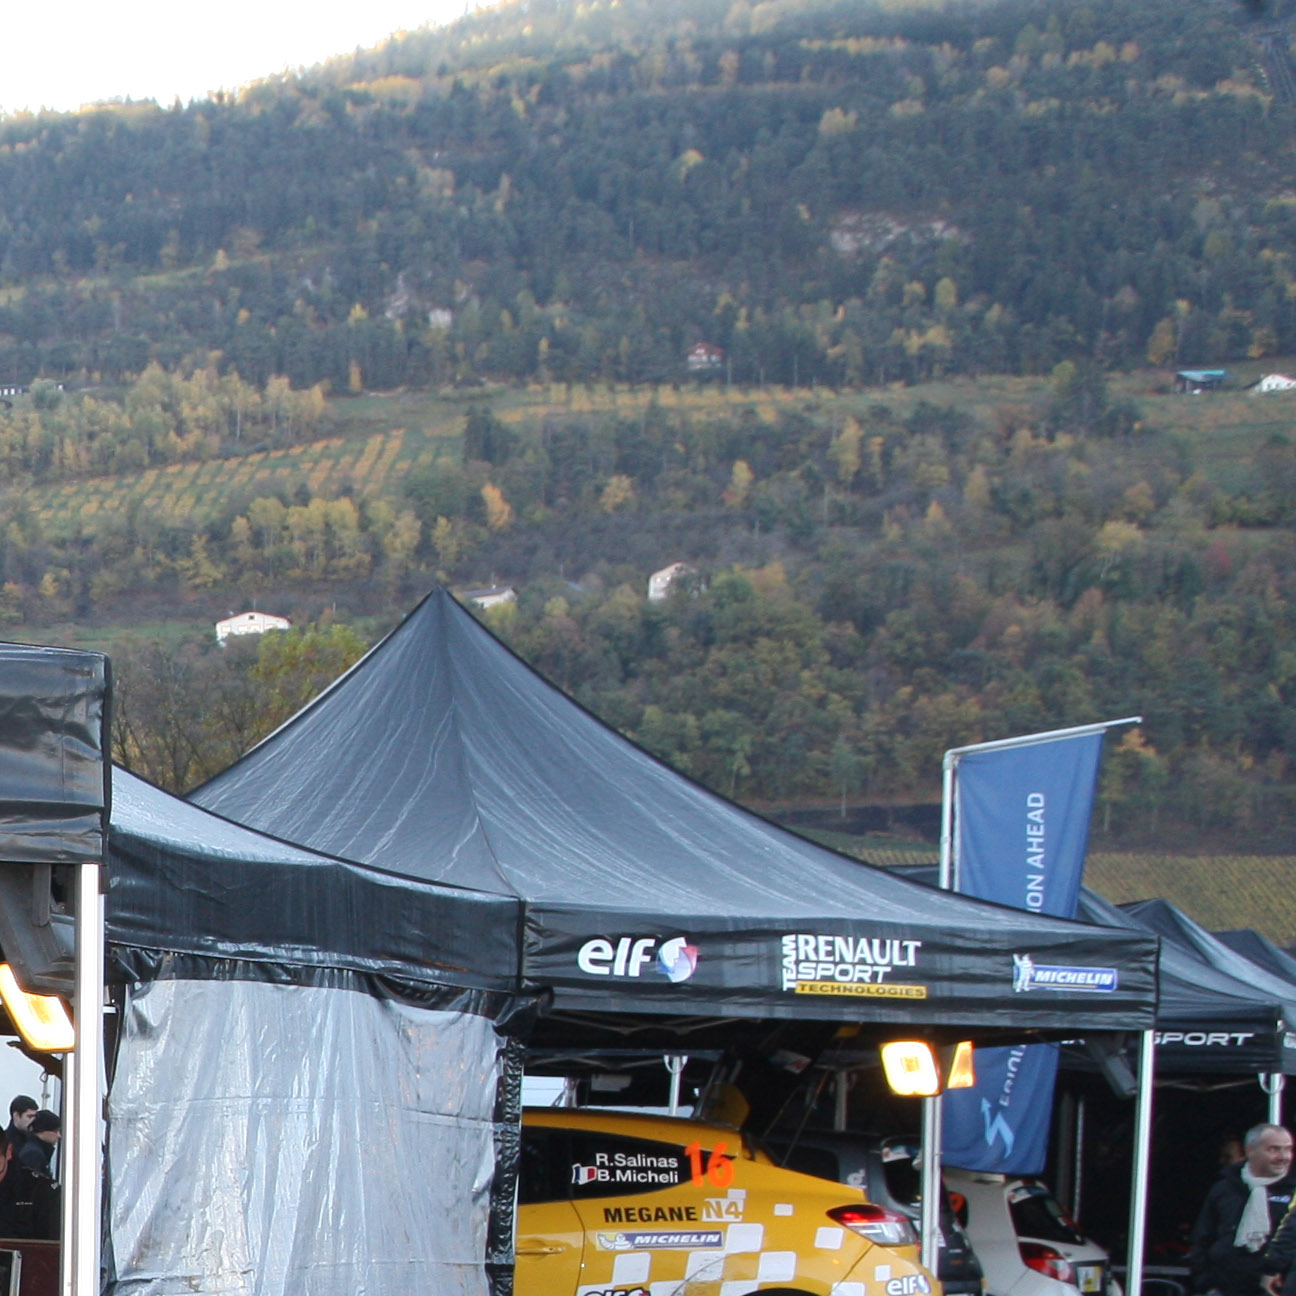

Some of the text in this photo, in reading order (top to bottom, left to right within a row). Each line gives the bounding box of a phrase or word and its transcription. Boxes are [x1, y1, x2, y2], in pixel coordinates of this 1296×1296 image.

[1027, 791, 1045, 869] AHEAD
[577, 936, 656, 977] elf
[797, 934, 922, 967] RENAULT
[782, 934, 797, 991] TEAM
[797, 961, 892, 984] SPORT
[1034, 969, 1115, 986] MICHELIN
[799, 983, 925, 997] TECHNOLOGIES
[1153, 1032, 1255, 1047] SPORT
[595, 1152, 678, 1169] R.Salinas
[684, 1140, 735, 1189] 16
[596, 1170, 679, 1184] B.Micheli
[604, 1203, 743, 1223] MEGANE N4
[634, 1233, 720, 1244] MICHELIN
[887, 1277, 918, 1296] elf
